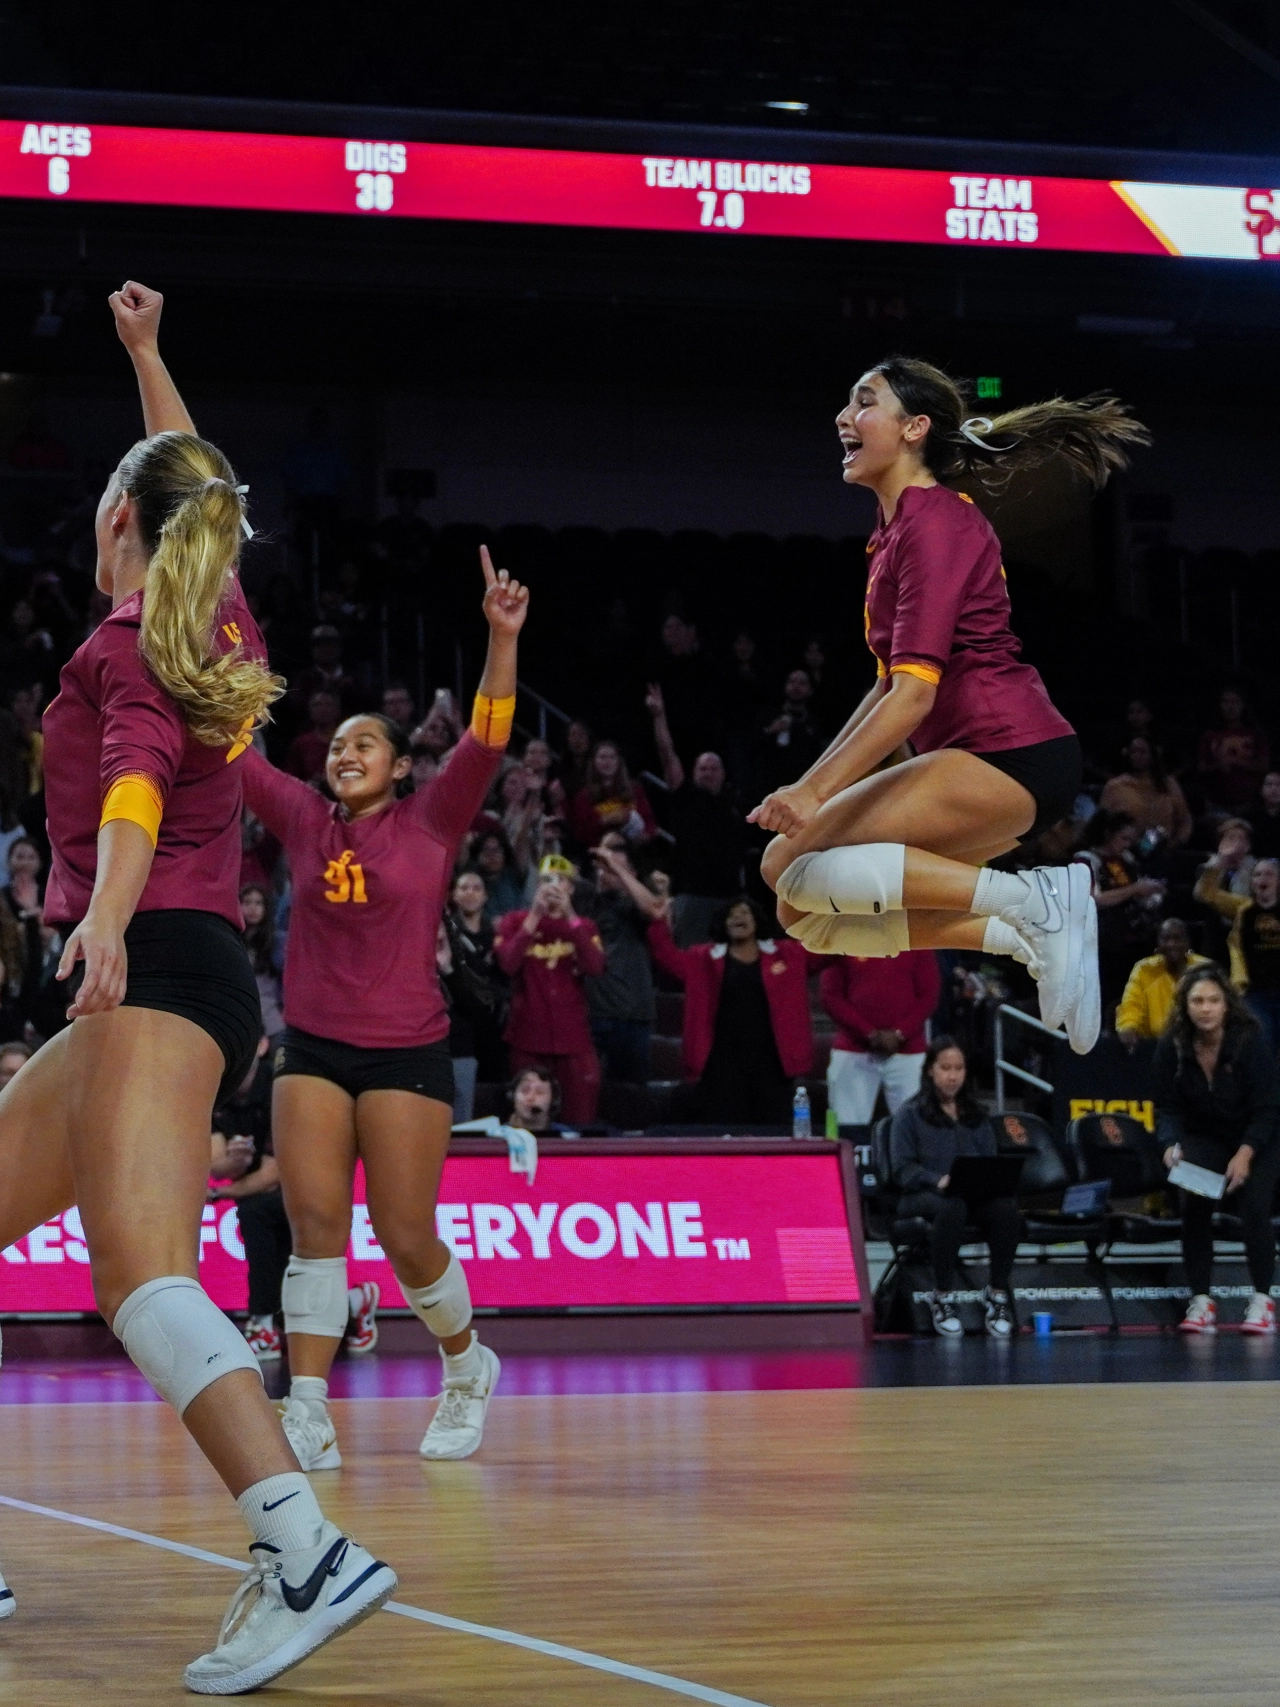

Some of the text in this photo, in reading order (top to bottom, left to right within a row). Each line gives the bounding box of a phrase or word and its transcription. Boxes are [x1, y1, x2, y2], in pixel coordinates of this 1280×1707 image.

[20, 124, 92, 157] ACES
[345, 141, 407, 173] DIGS
[48, 156, 70, 195] 6
[642, 158, 812, 195] TEAM BLOCKS
[697, 191, 745, 229] 7.0
[949, 176, 1032, 210] TEAM
[946, 208, 1039, 243] STATS
[351, 1201, 707, 1260] EERYONE
[712, 1238, 751, 1260] TM
[1013, 1286, 1102, 1301] POWERADE
[1110, 1286, 1194, 1301] POWERAD
